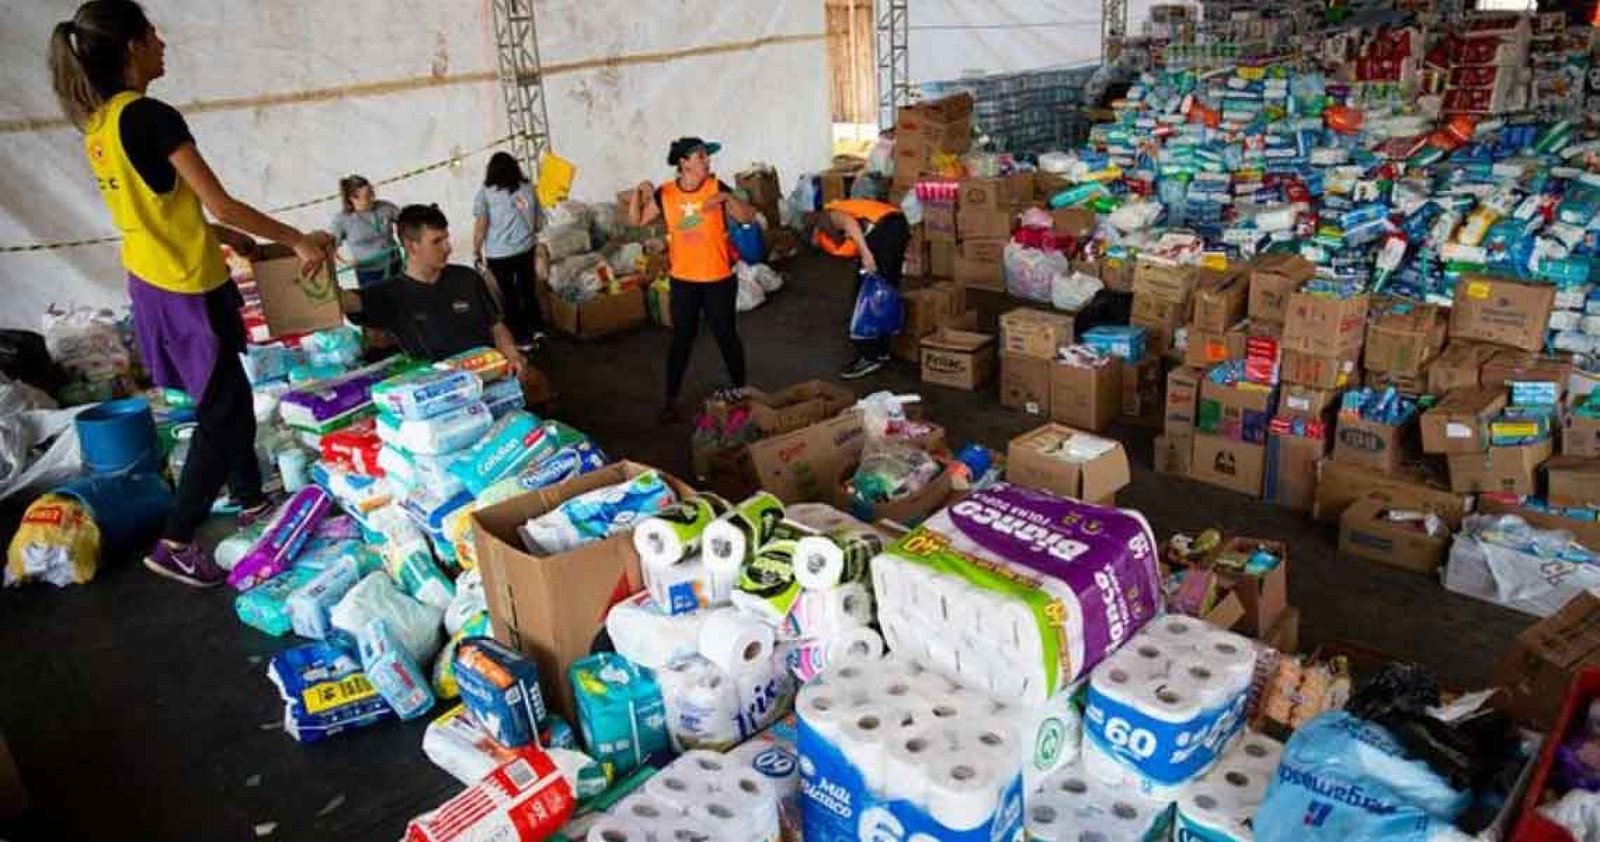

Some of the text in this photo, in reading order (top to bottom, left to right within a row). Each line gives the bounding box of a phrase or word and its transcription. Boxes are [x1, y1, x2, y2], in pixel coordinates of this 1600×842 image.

[951, 500, 1090, 562] Bianco
[1094, 570, 1126, 654] ianco
[1104, 716, 1158, 758] 60
